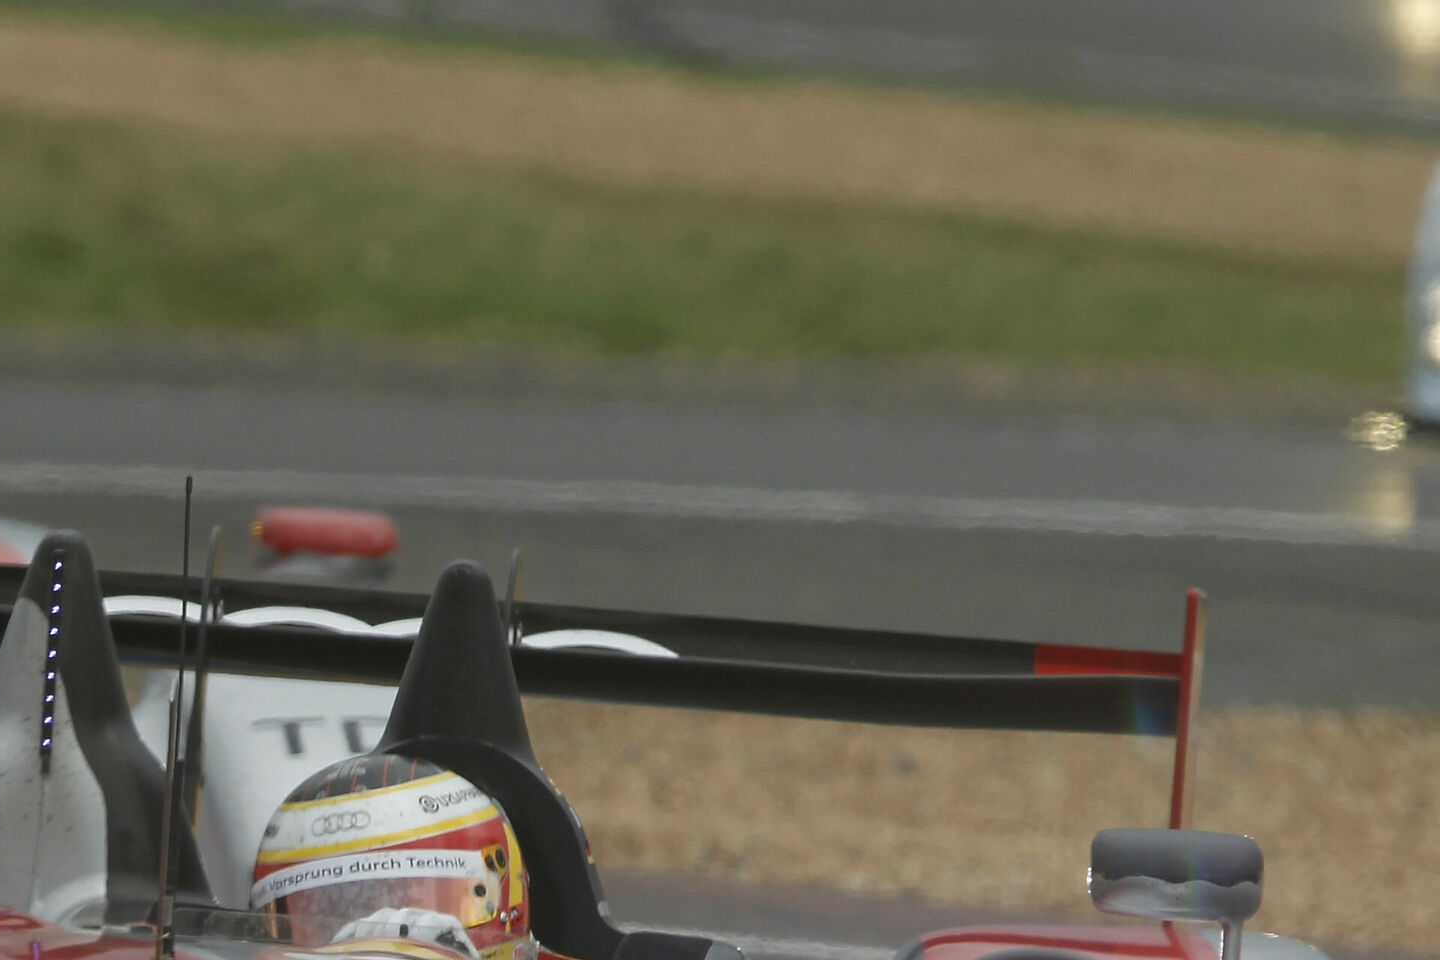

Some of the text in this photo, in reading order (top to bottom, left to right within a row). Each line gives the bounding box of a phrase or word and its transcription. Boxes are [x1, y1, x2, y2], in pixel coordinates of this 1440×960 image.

[268, 865, 343, 893] Vorsprung
[349, 858, 401, 874] durch
[406, 857, 466, 870] Technik
